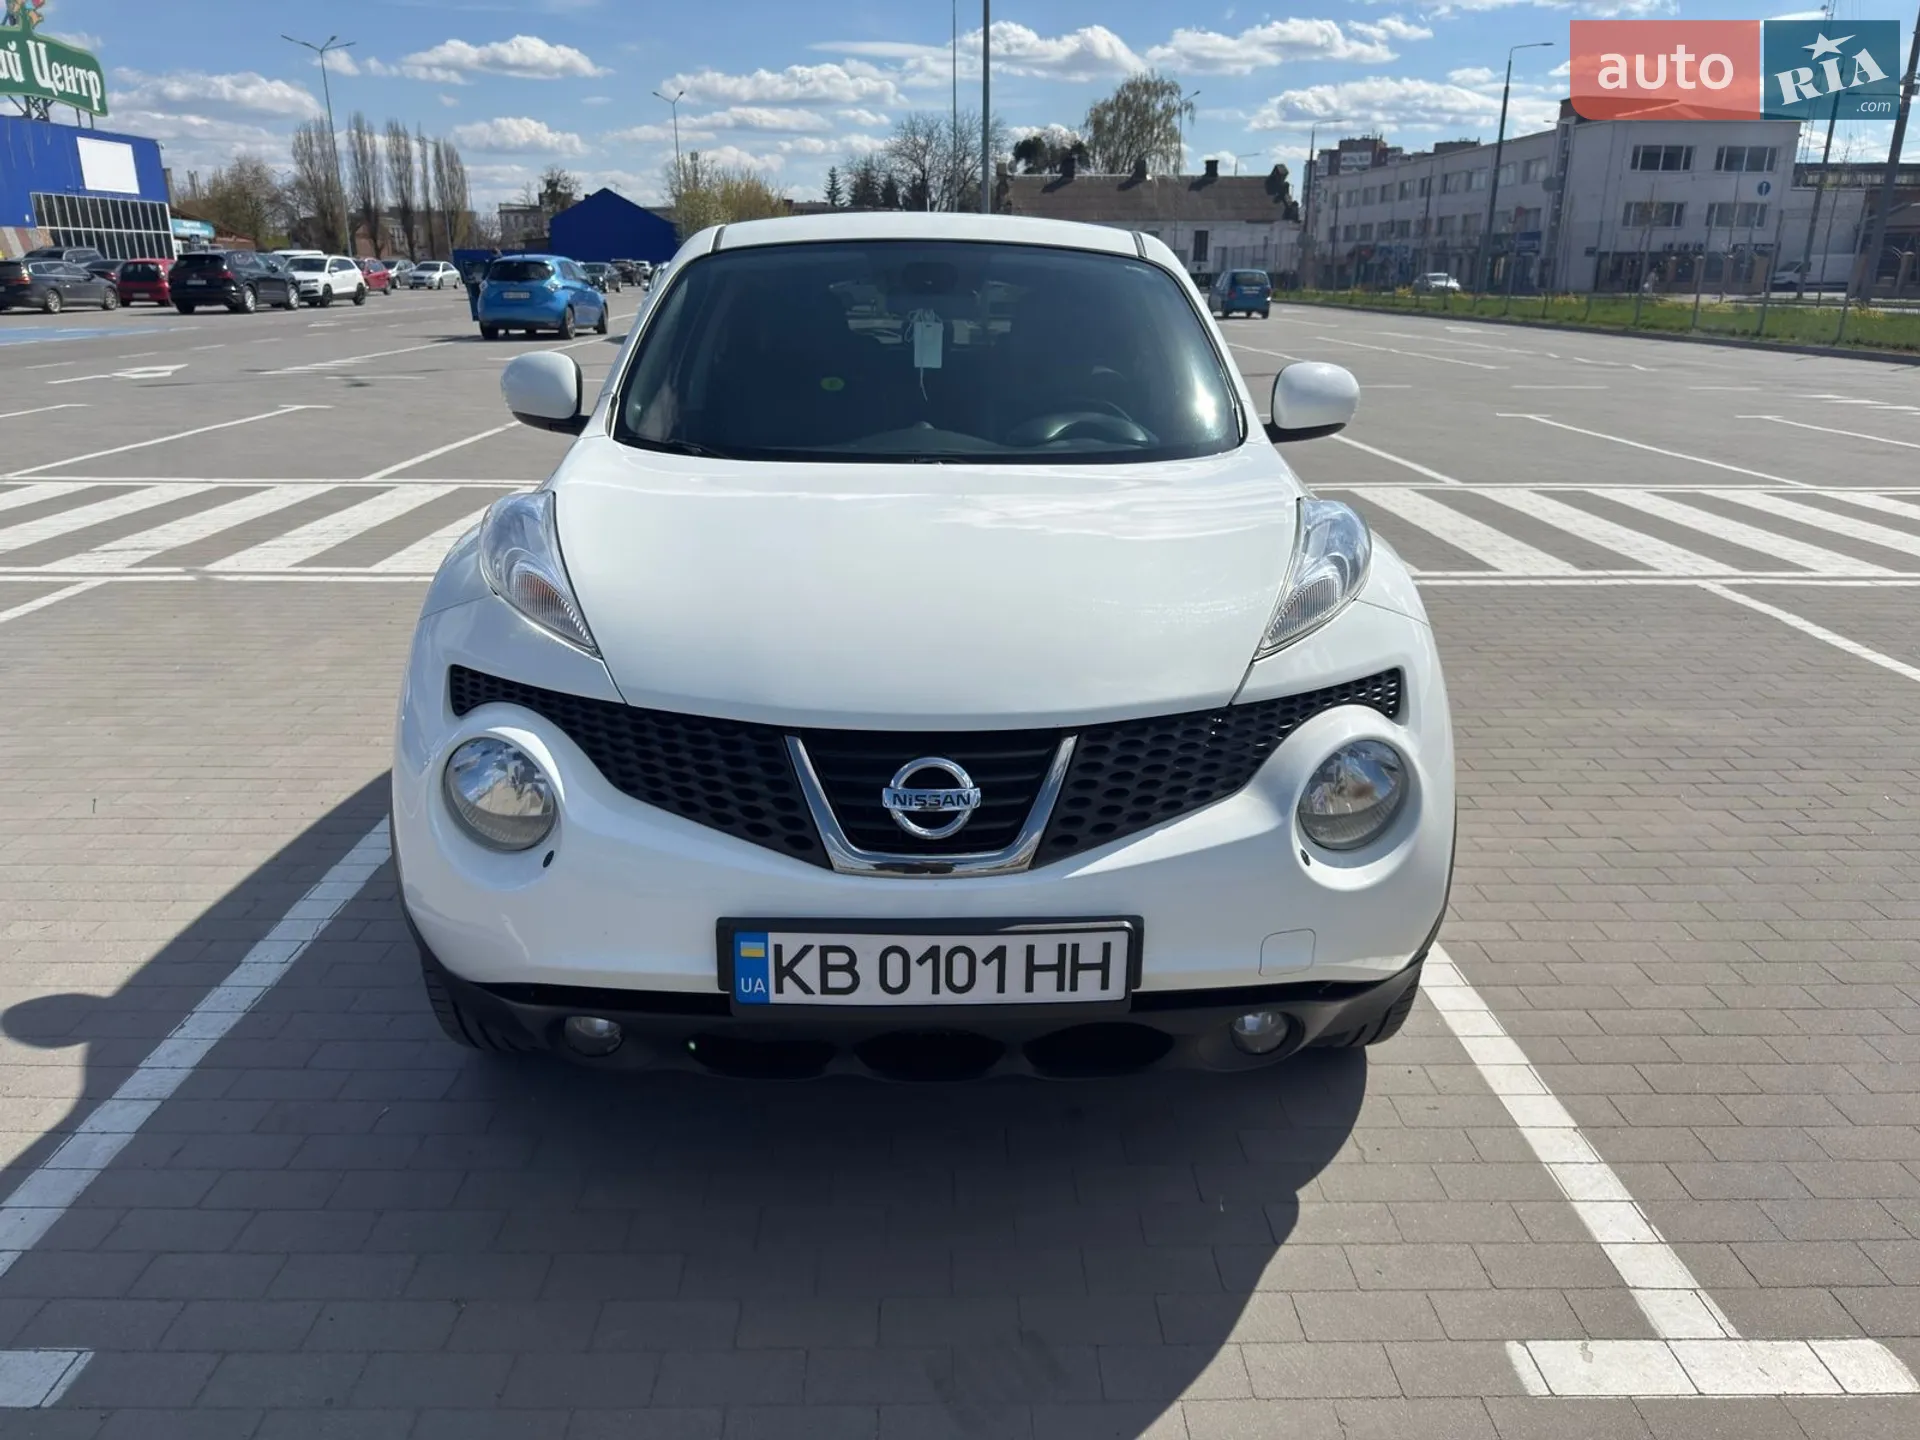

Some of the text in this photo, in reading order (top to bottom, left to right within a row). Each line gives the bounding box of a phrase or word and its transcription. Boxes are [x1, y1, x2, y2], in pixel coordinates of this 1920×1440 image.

[26, 39, 101, 111] Центр
[740, 977, 766, 994] UA
[773, 941, 1112, 996] KB 0101 HH
